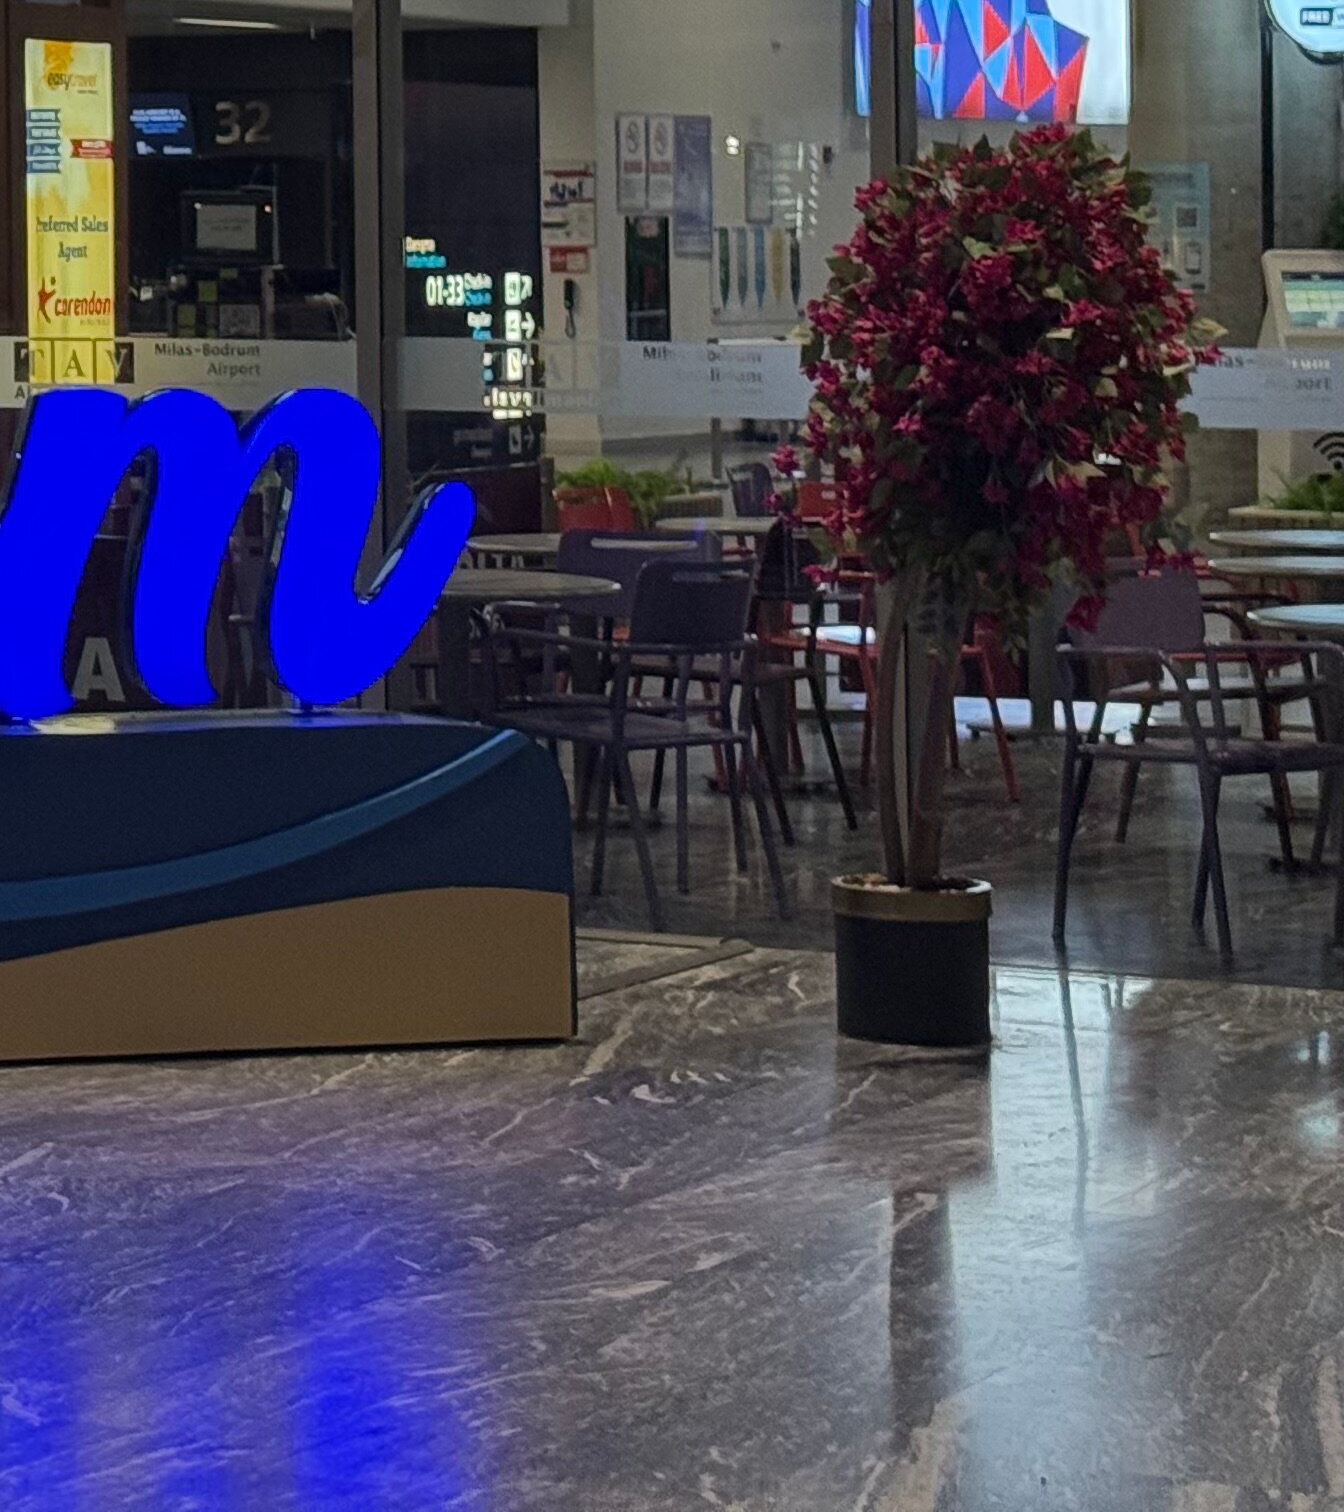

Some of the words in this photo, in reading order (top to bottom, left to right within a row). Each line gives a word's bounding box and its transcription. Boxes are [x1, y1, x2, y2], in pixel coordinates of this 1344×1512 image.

[215, 100, 272, 145] 32
[58, 241, 88, 262] Agent
[54, 291, 111, 316] corendon
[155, 343, 260, 356] Milas-Bodrum
[207, 362, 260, 378] Airport
